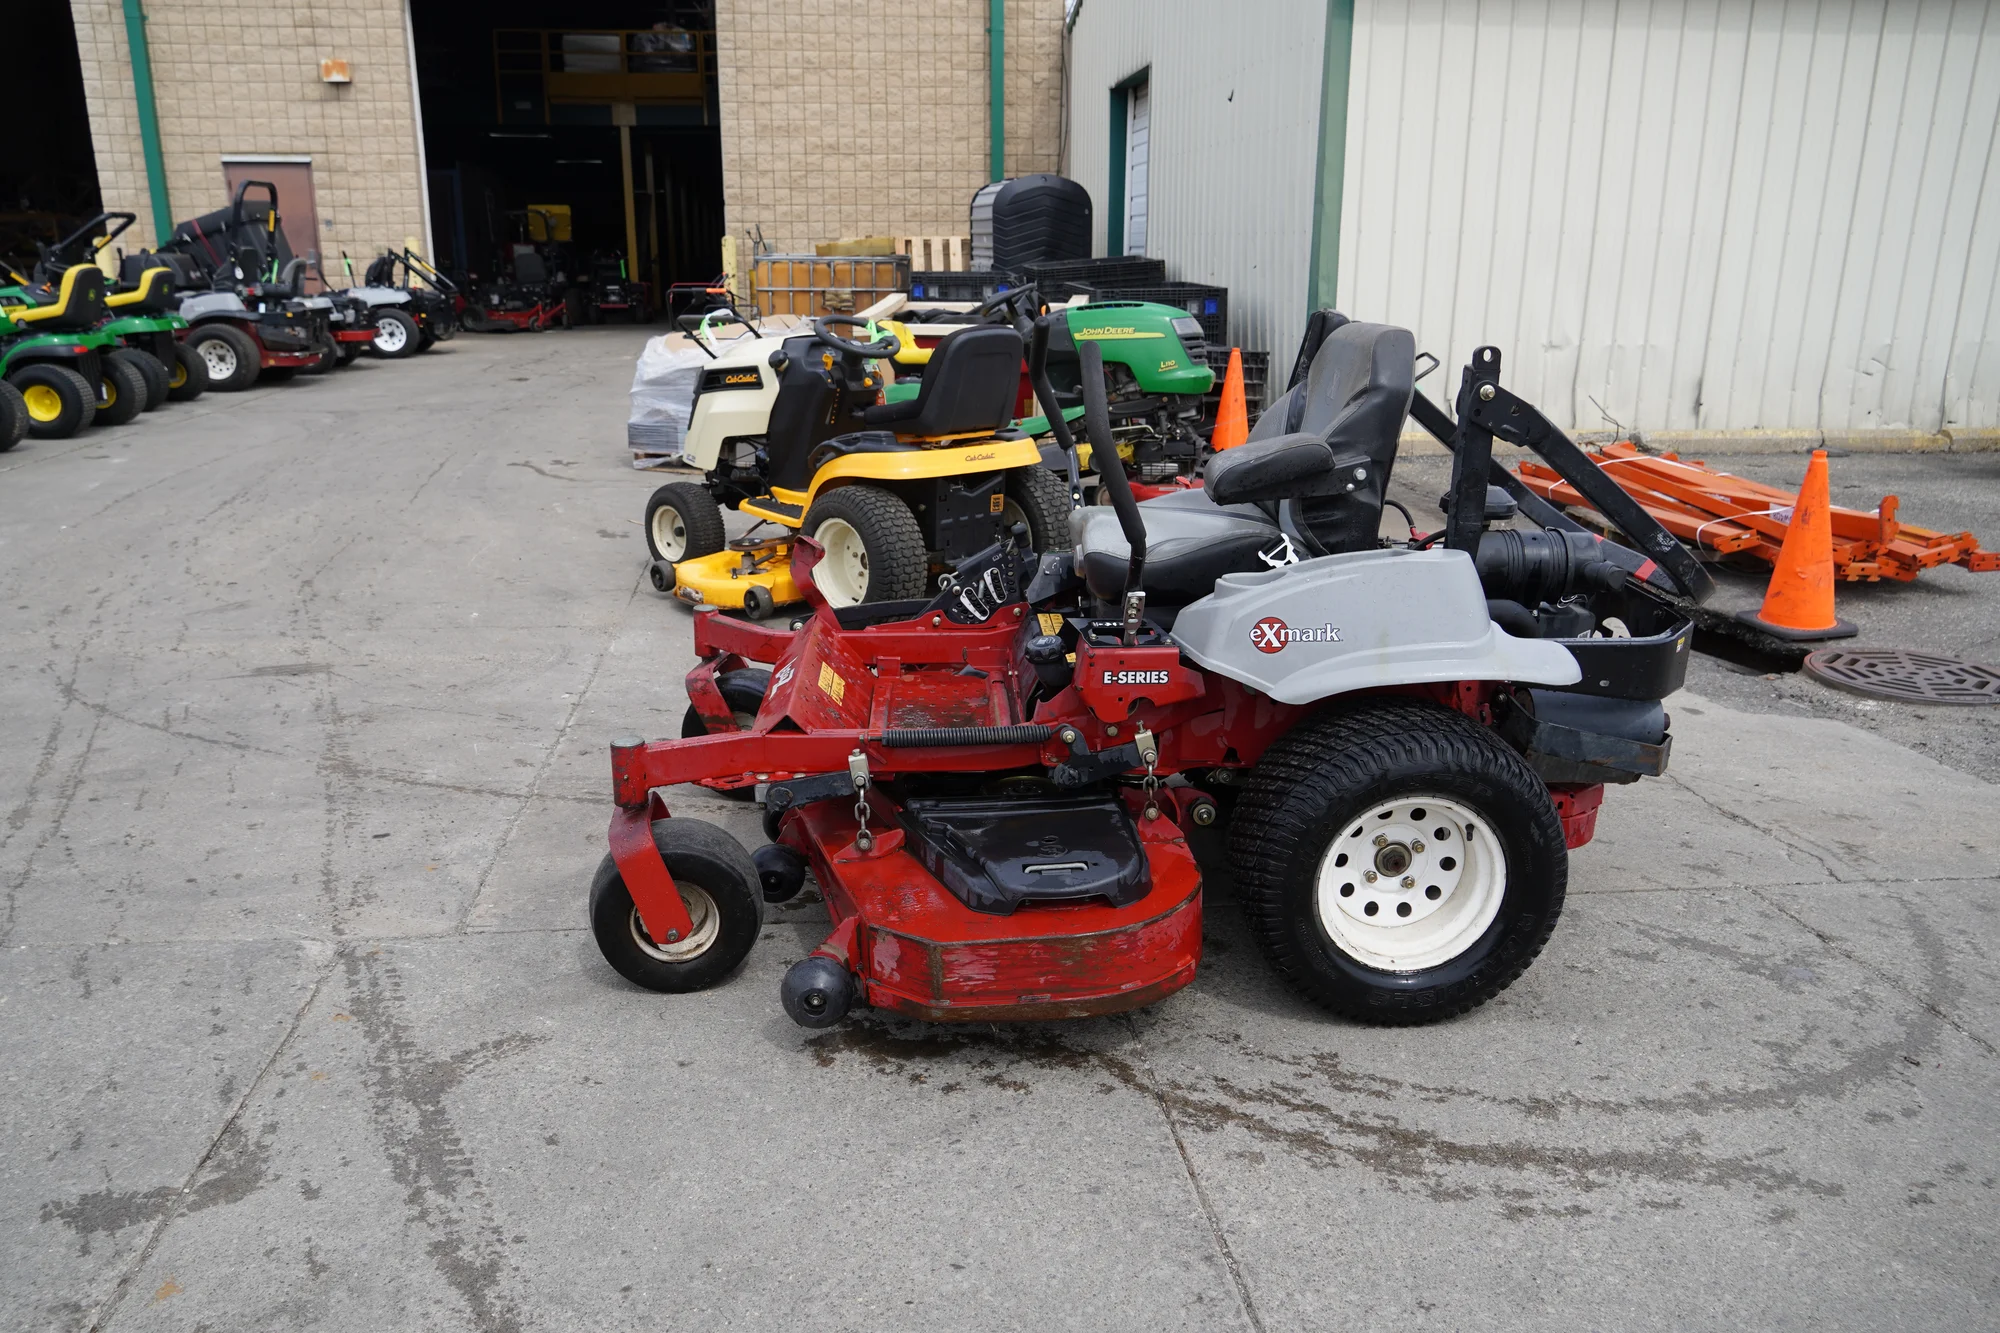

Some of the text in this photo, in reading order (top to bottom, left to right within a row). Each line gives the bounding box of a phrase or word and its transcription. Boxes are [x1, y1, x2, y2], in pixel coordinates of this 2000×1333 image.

[1080, 326, 1135, 336] JOHN DEERE
[1103, 671, 1169, 684] E-SERIES
